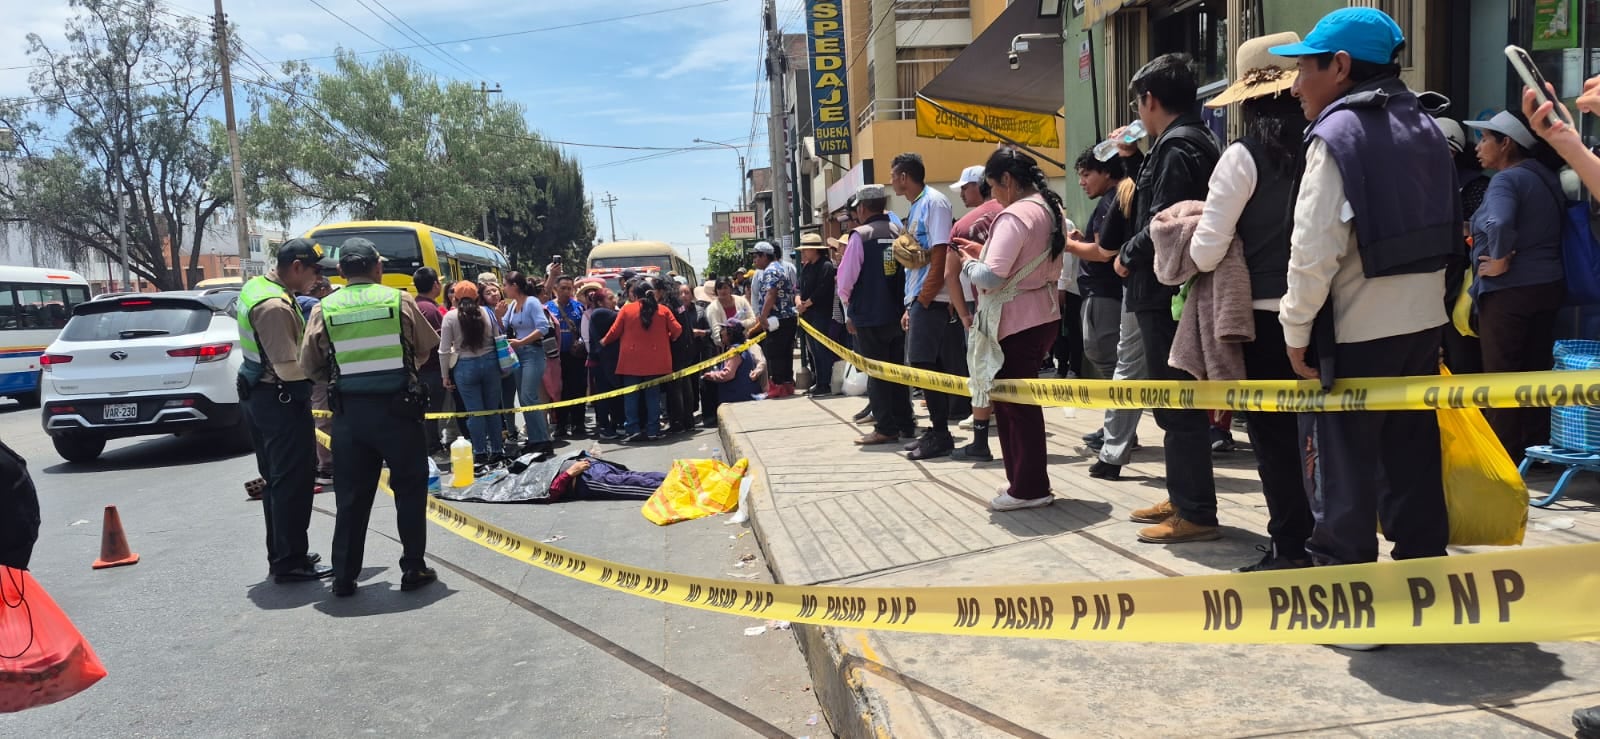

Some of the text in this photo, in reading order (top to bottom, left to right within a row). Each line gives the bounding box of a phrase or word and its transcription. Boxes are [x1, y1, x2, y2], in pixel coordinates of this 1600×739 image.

[812, 0, 845, 122] SPEDAJE
[816, 127, 849, 139] BUENA
[819, 140, 848, 151] VISTA
[105, 406, 136, 418] VAR-230
[600, 566, 612, 583] NO
[615, 570, 641, 589] PASAR
[685, 583, 702, 602] NO
[705, 586, 738, 610] PASAR
[797, 594, 818, 618] NO
[822, 596, 866, 622] PASAR
[1203, 568, 1526, 631] NO PASAR PNP
[953, 592, 1136, 630] NO PASAR PNP
